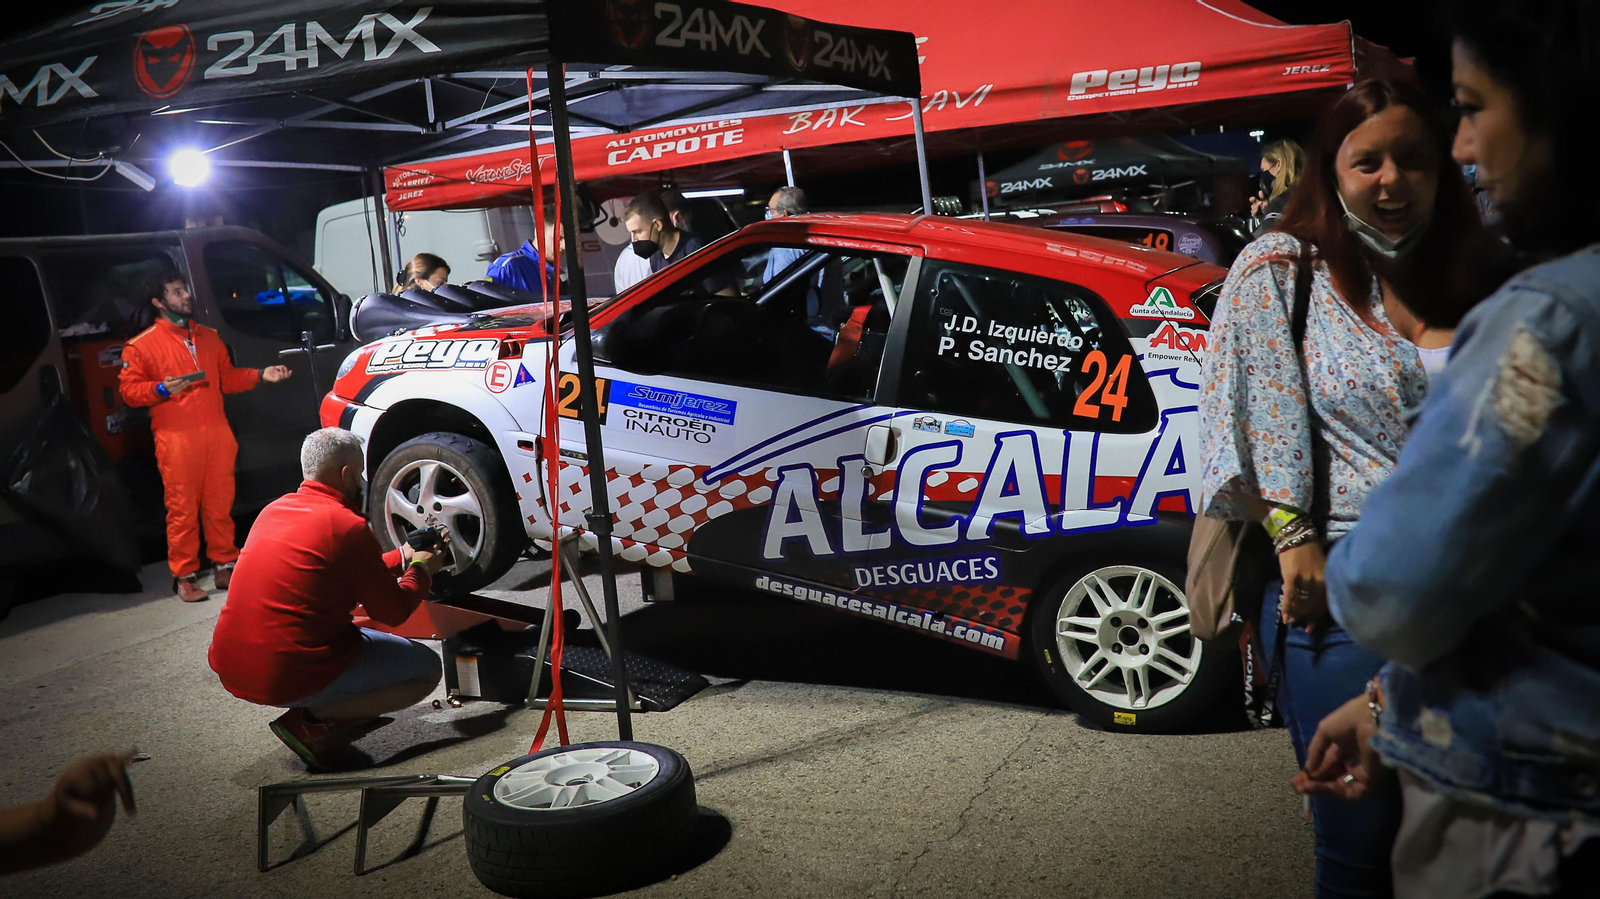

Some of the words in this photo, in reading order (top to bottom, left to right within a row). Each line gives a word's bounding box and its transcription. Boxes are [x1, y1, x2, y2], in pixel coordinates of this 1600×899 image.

[203, 7, 442, 80] 24MX
[654, 2, 771, 58] 24MX
[813, 30, 892, 81] 24MX
[1283, 64, 1331, 76] JEREZ
[1069, 61, 1202, 95] Peyo
[605, 119, 743, 149] AUTOMOVILES
[607, 129, 745, 166] CAPOTE
[1001, 177, 1053, 194] 24MX
[1092, 165, 1148, 181] 24MX
[398, 190, 424, 201] JEREZ
[1160, 310, 1193, 318] Andalucía
[943, 314, 982, 335] J.D.
[987, 319, 1084, 349] Izquierdo
[370, 339, 498, 369] Peyo
[937, 336, 960, 358] P.
[967, 340, 1072, 373] Sanchez
[1148, 352, 1184, 362] Empower
[490, 364, 507, 387] E
[1072, 349, 1133, 422] 24
[625, 418, 712, 444] INAUTO
[667, 408, 687, 416] Turismos
[708, 415, 731, 424] Industrial
[854, 556, 999, 588] DESGUACES
[755, 575, 1005, 651] desguacesalcala.com
